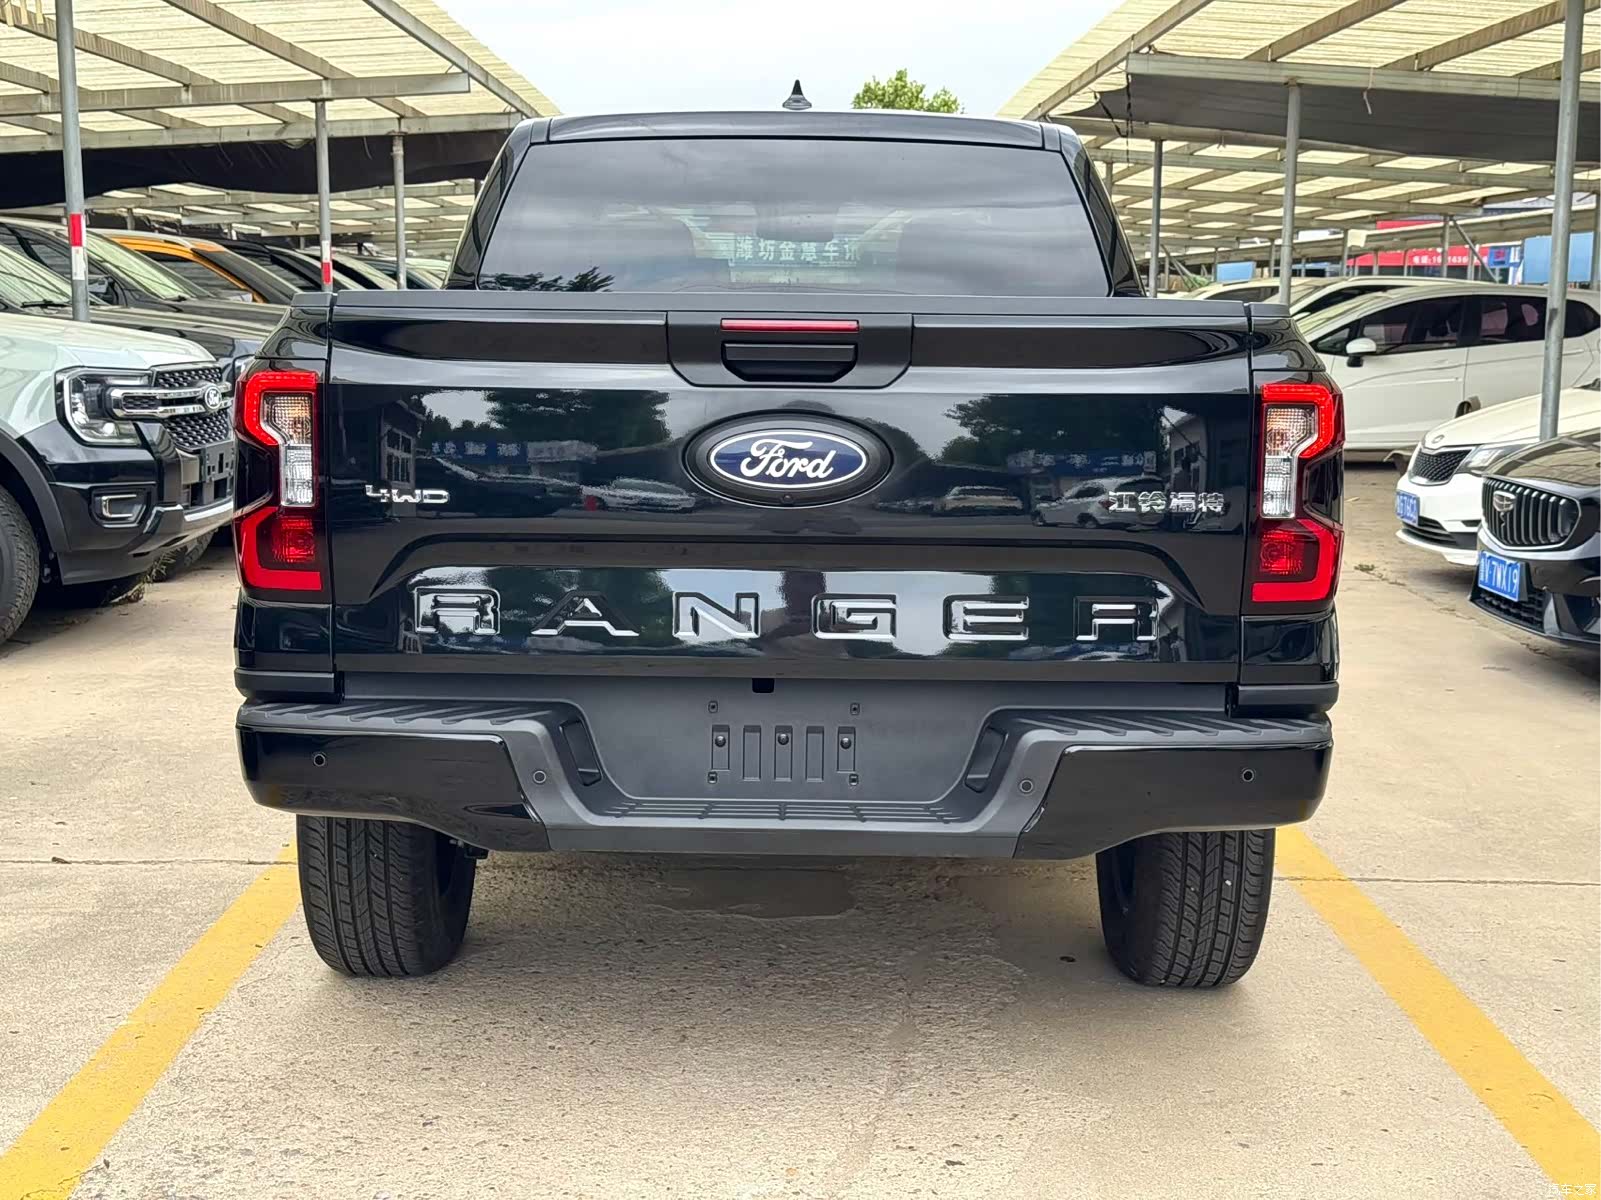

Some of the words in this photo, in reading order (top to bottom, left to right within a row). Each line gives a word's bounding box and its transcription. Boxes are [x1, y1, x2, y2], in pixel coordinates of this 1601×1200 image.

[740, 438, 837, 479] Ford
[364, 484, 450, 504] 4WD
[1108, 490, 1225, 514] 江铃福特
[413, 587, 1160, 641] RANGER
